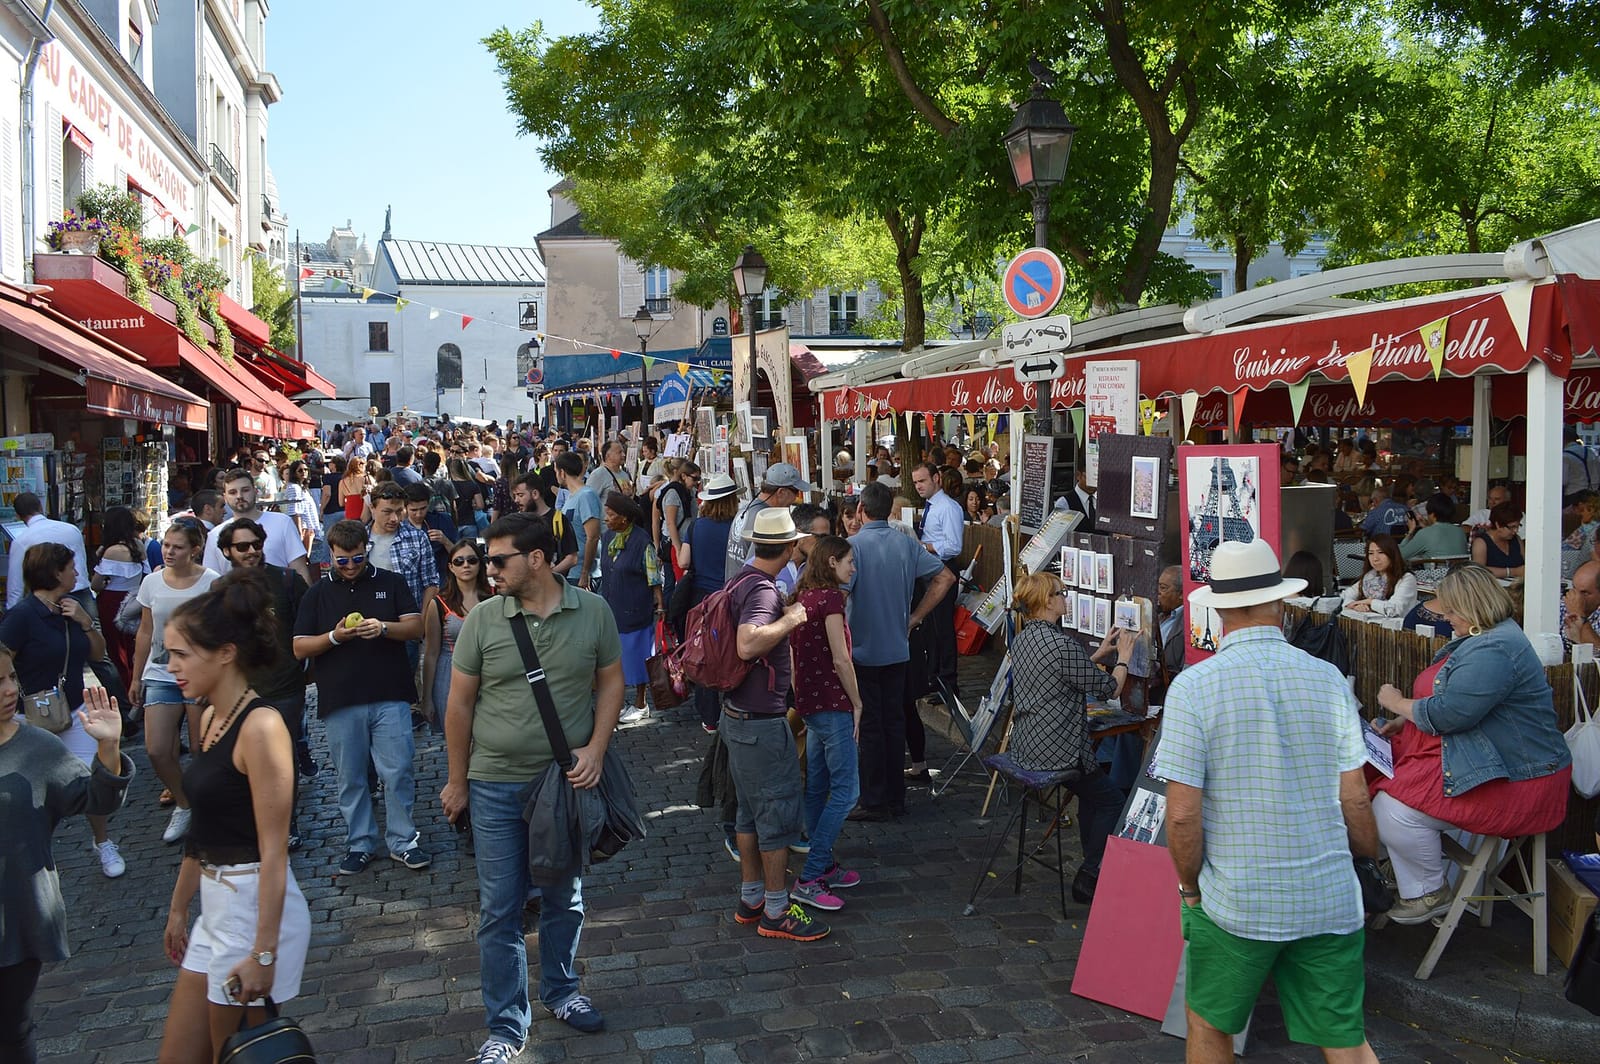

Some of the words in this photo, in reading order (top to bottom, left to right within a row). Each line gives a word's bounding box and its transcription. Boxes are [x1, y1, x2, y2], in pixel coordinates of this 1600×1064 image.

[39, 43, 60, 87] AU
[68, 65, 112, 137] CADET
[118, 115, 132, 159] DE
[138, 138, 187, 212] GASCOGNE
[80, 315, 145, 329] staurant
[1232, 347, 1311, 381] Cuisine
[1317, 317, 1495, 367] traitionelle
[950, 379, 970, 406] La
[976, 376, 1014, 405] Mère
[1020, 371, 1086, 401] Cheri
[1564, 376, 1600, 409] La
[1194, 400, 1224, 423] Café
[1310, 393, 1376, 423] Crêpes
